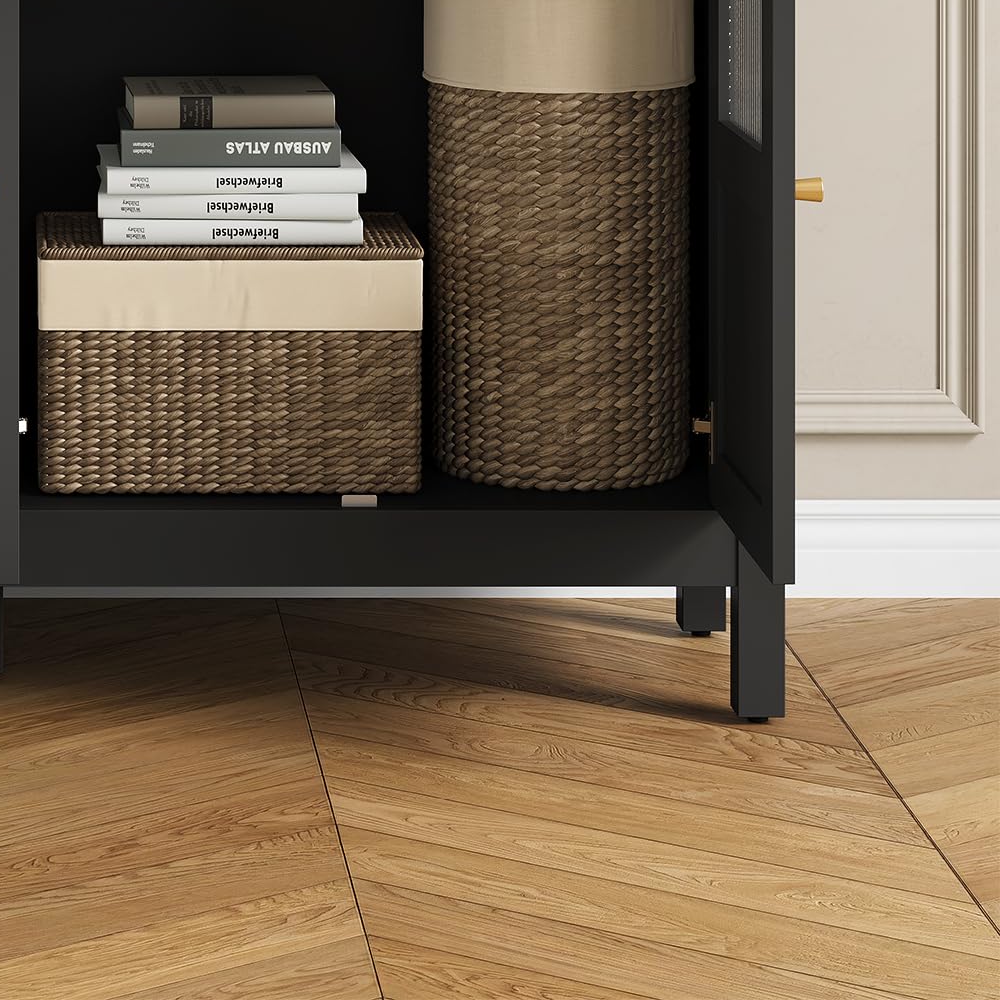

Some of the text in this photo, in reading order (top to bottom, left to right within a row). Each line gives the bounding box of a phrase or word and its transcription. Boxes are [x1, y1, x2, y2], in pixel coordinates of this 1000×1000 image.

[226, 142, 332, 155] AUSBAU ATLAS
[216, 177, 283, 189] Briefwechsel
[206, 202, 274, 214] Briefwechsel
[212, 228, 279, 240] Briefwechsel
